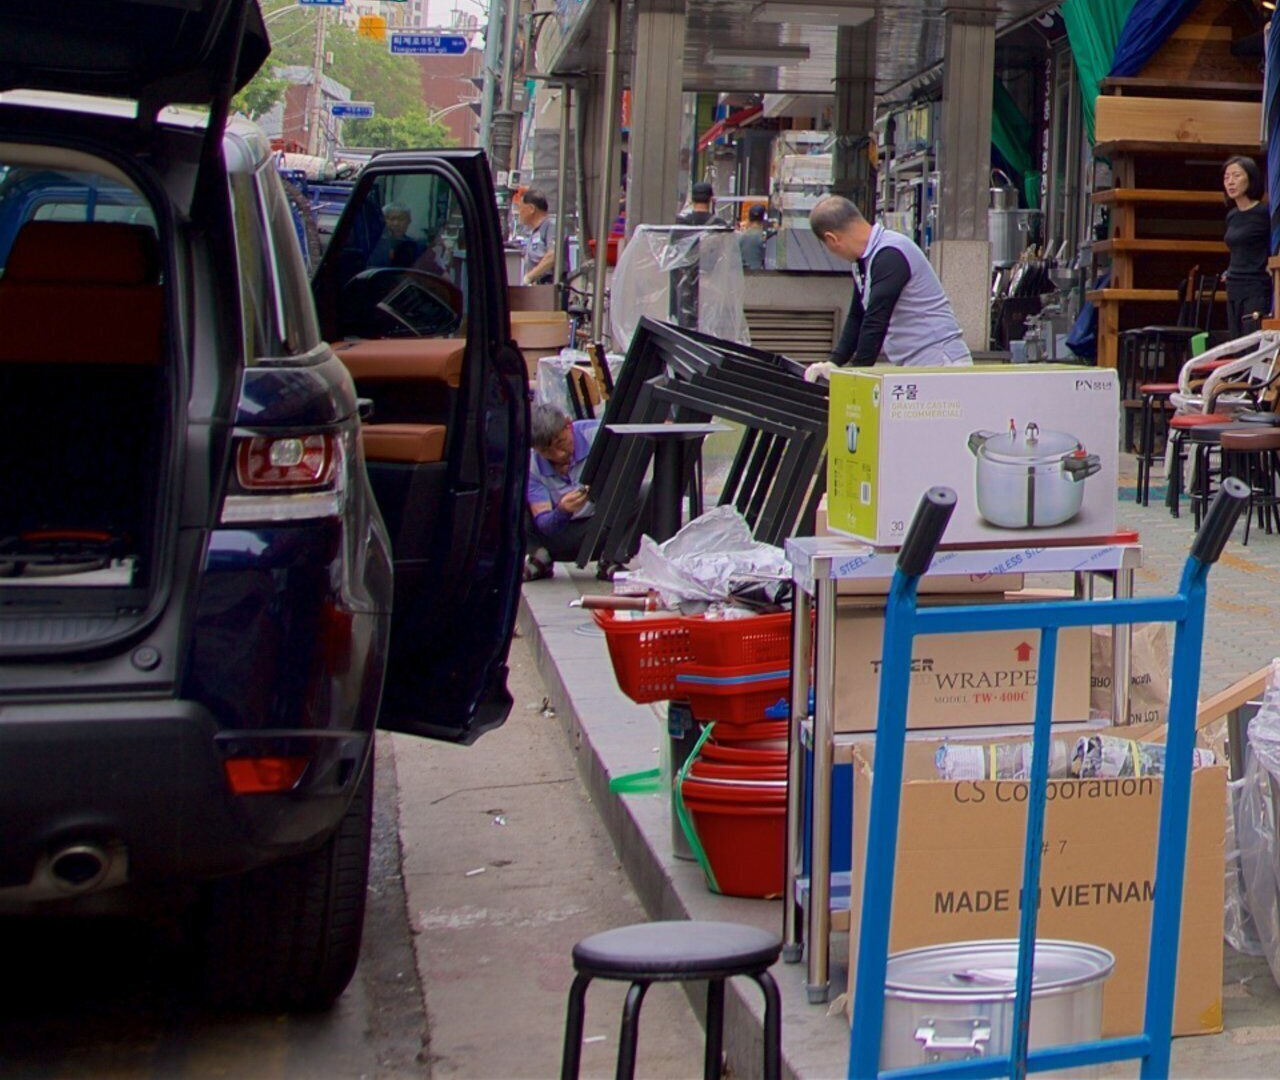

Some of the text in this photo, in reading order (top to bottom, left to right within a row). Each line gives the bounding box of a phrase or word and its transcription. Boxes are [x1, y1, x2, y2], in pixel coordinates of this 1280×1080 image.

[890, 384, 919, 401] 주물
[891, 520, 905, 532] 30
[869, 657, 935, 674] TER
[934, 694, 969, 705] MODEL
[1144, 710, 1160, 723] LOT
[953, 776, 1154, 804] CS Coporation
[934, 888, 1010, 914] MADE
